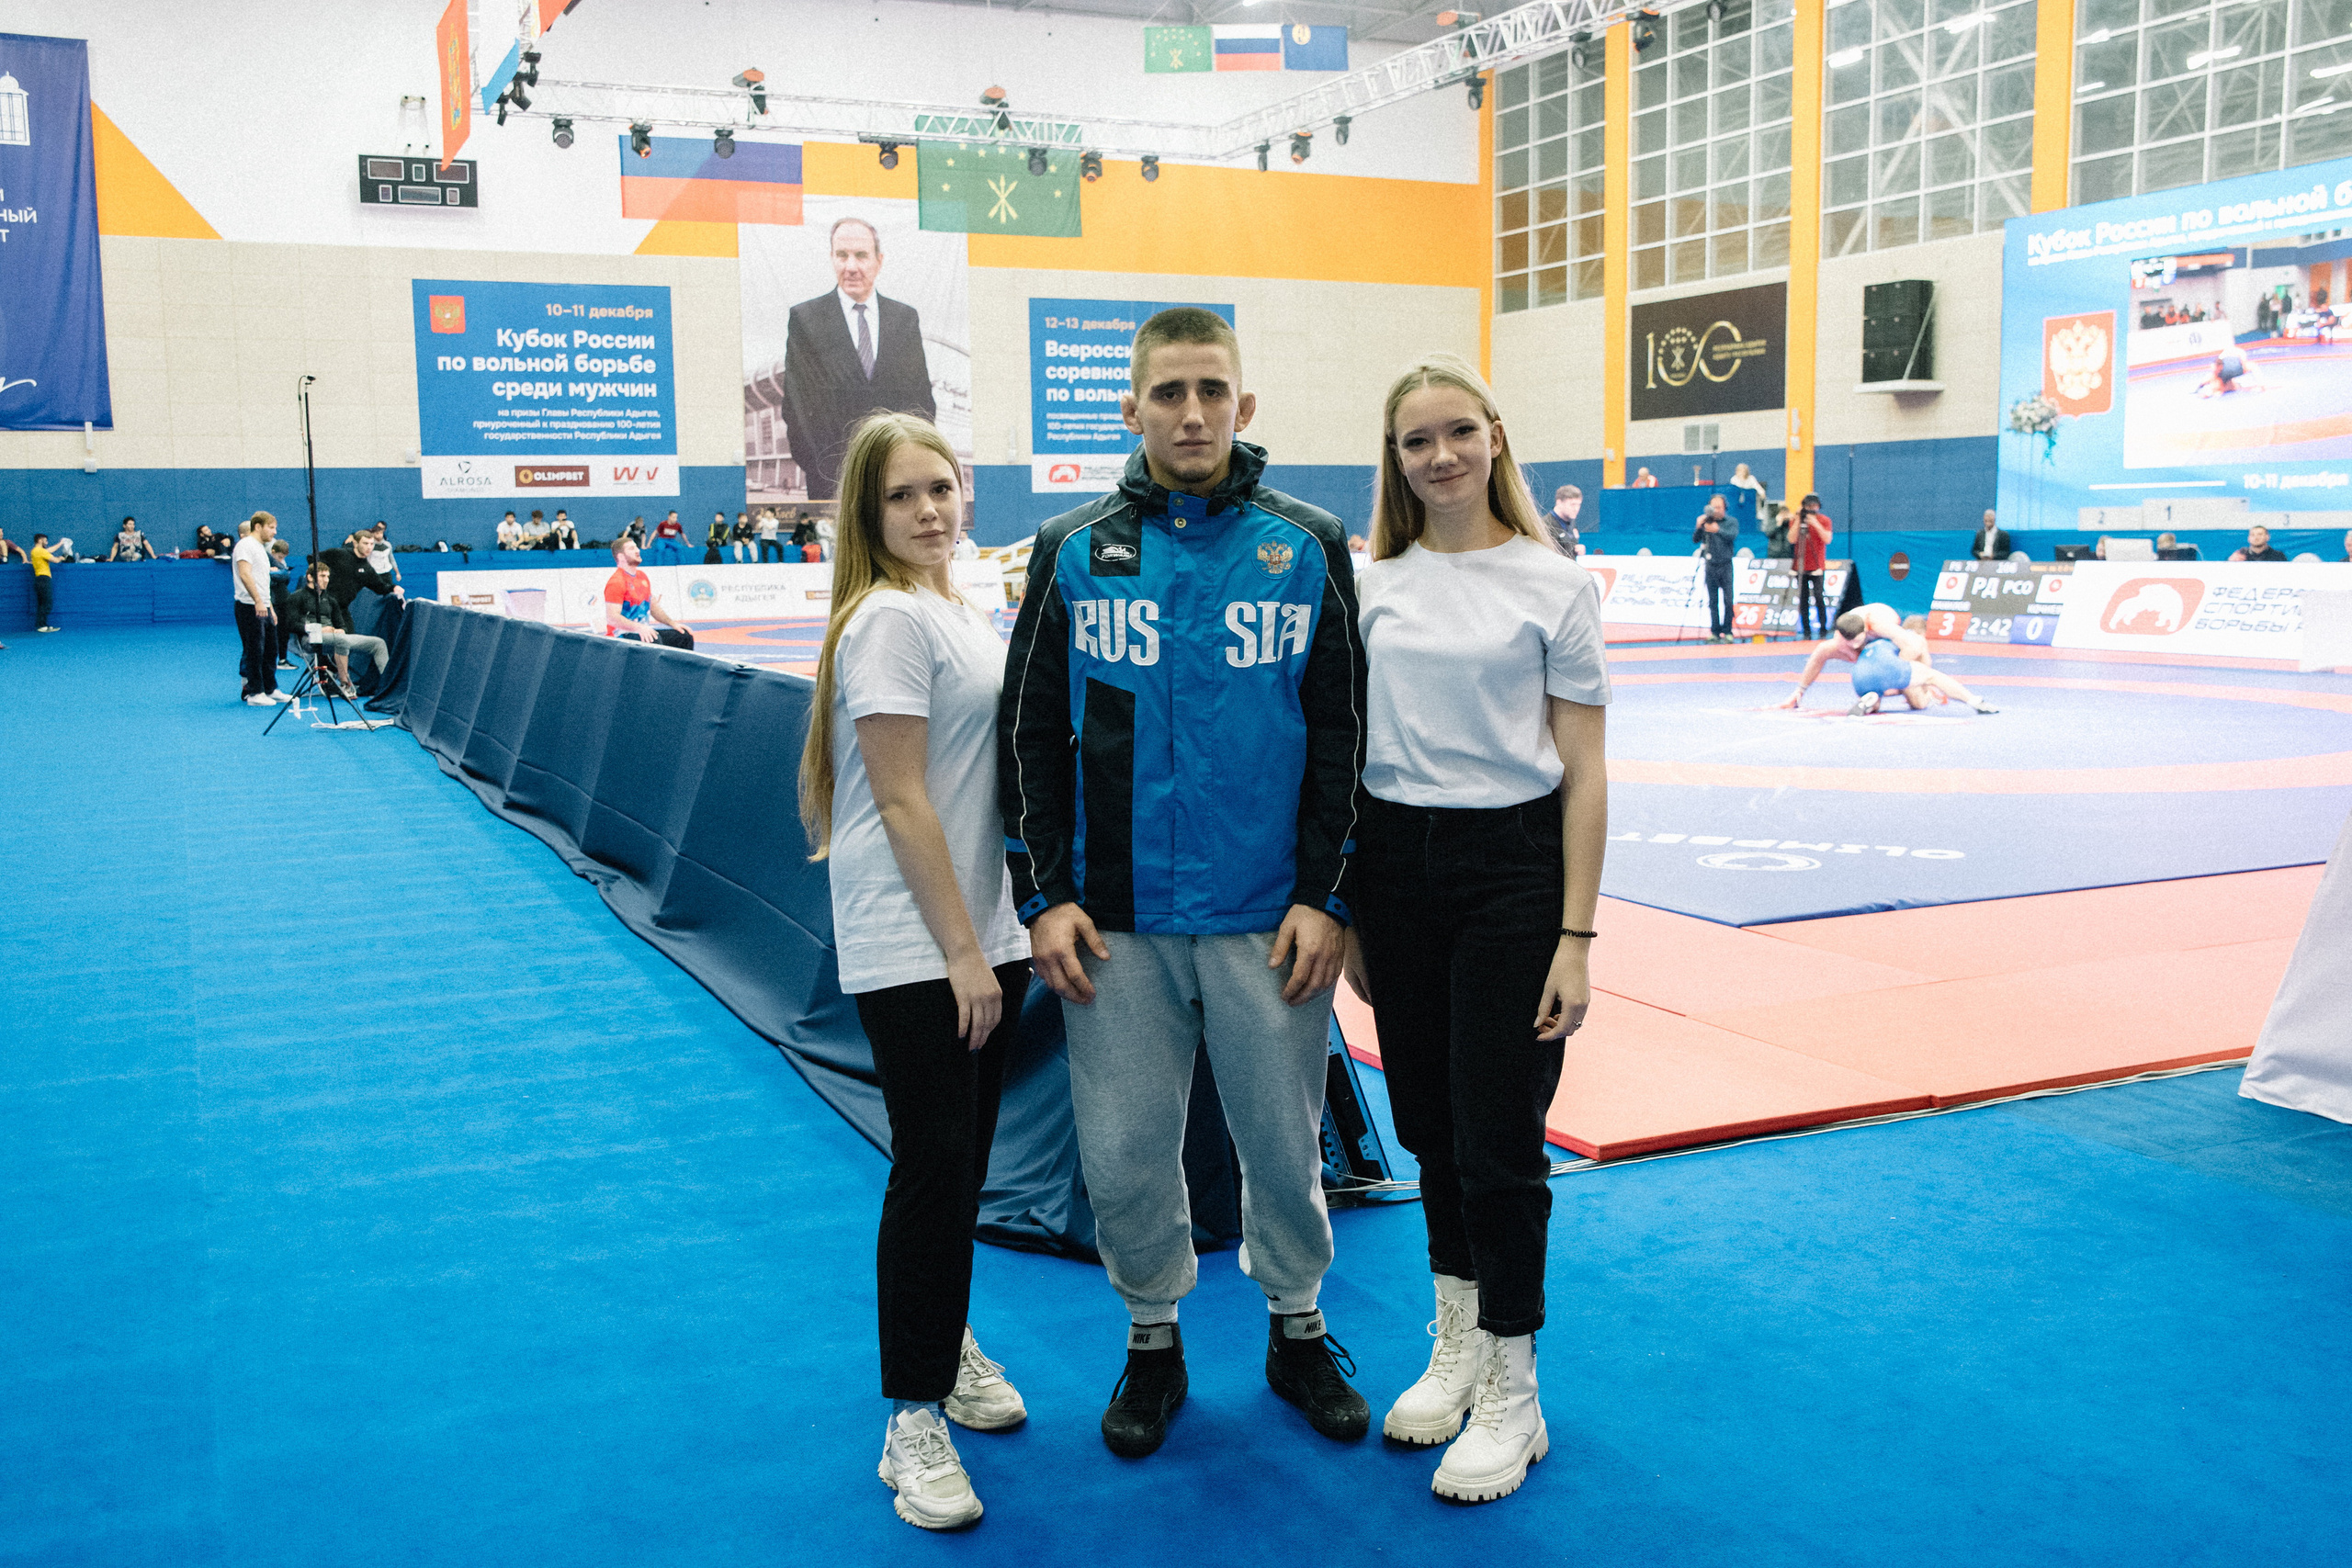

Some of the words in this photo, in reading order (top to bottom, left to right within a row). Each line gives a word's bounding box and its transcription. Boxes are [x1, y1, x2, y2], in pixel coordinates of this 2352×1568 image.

[2028, 228, 2092, 258] Кубок
[2181, 209, 2213, 231] по
[2218, 184, 2328, 225] вольной
[589, 305, 653, 321] декабря
[1081, 319, 1136, 333] декабря
[496, 328, 568, 353] Кубок
[573, 330, 655, 349] России
[437, 355, 467, 371] по
[472, 354, 569, 372] вольной
[575, 354, 656, 377] борьбе
[492, 380, 562, 400] среди
[569, 382, 657, 402] мужчин
[1046, 389, 1070, 401] по
[511, 410, 540, 419] призы
[541, 408, 570, 417] Главы
[571, 409, 624, 419] Республики
[473, 420, 541, 430] приуроченный
[616, 420, 661, 429] 100-летия
[484, 432, 573, 441] государственности
[574, 431, 627, 442] Республики
[628, 432, 662, 441] Адыгея
[440, 477, 492, 486] ALROSA
[533, 470, 584, 481] OLIMPBET
[2280, 471, 2349, 491] декабря
[2098, 511, 2105, 525] 2
[2165, 505, 2172, 521] 1
[2282, 513, 2290, 526] 3
[1971, 577, 2000, 599] РД
[2002, 580, 2034, 595] РСО
[1736, 605, 1759, 626] 26
[1763, 608, 1799, 626] 3:00
[1939, 613, 1955, 636] 3
[1967, 617, 2012, 636] 2:42
[2025, 616, 2044, 640] 0
[2194, 618, 2290, 632] БОРЬБЫ
[1071, 599, 1159, 666] RUS
[1225, 601, 1312, 668] SIA
[1304, 1319, 1322, 1335] NIKE
[1132, 1333, 1151, 1344] NIKE
